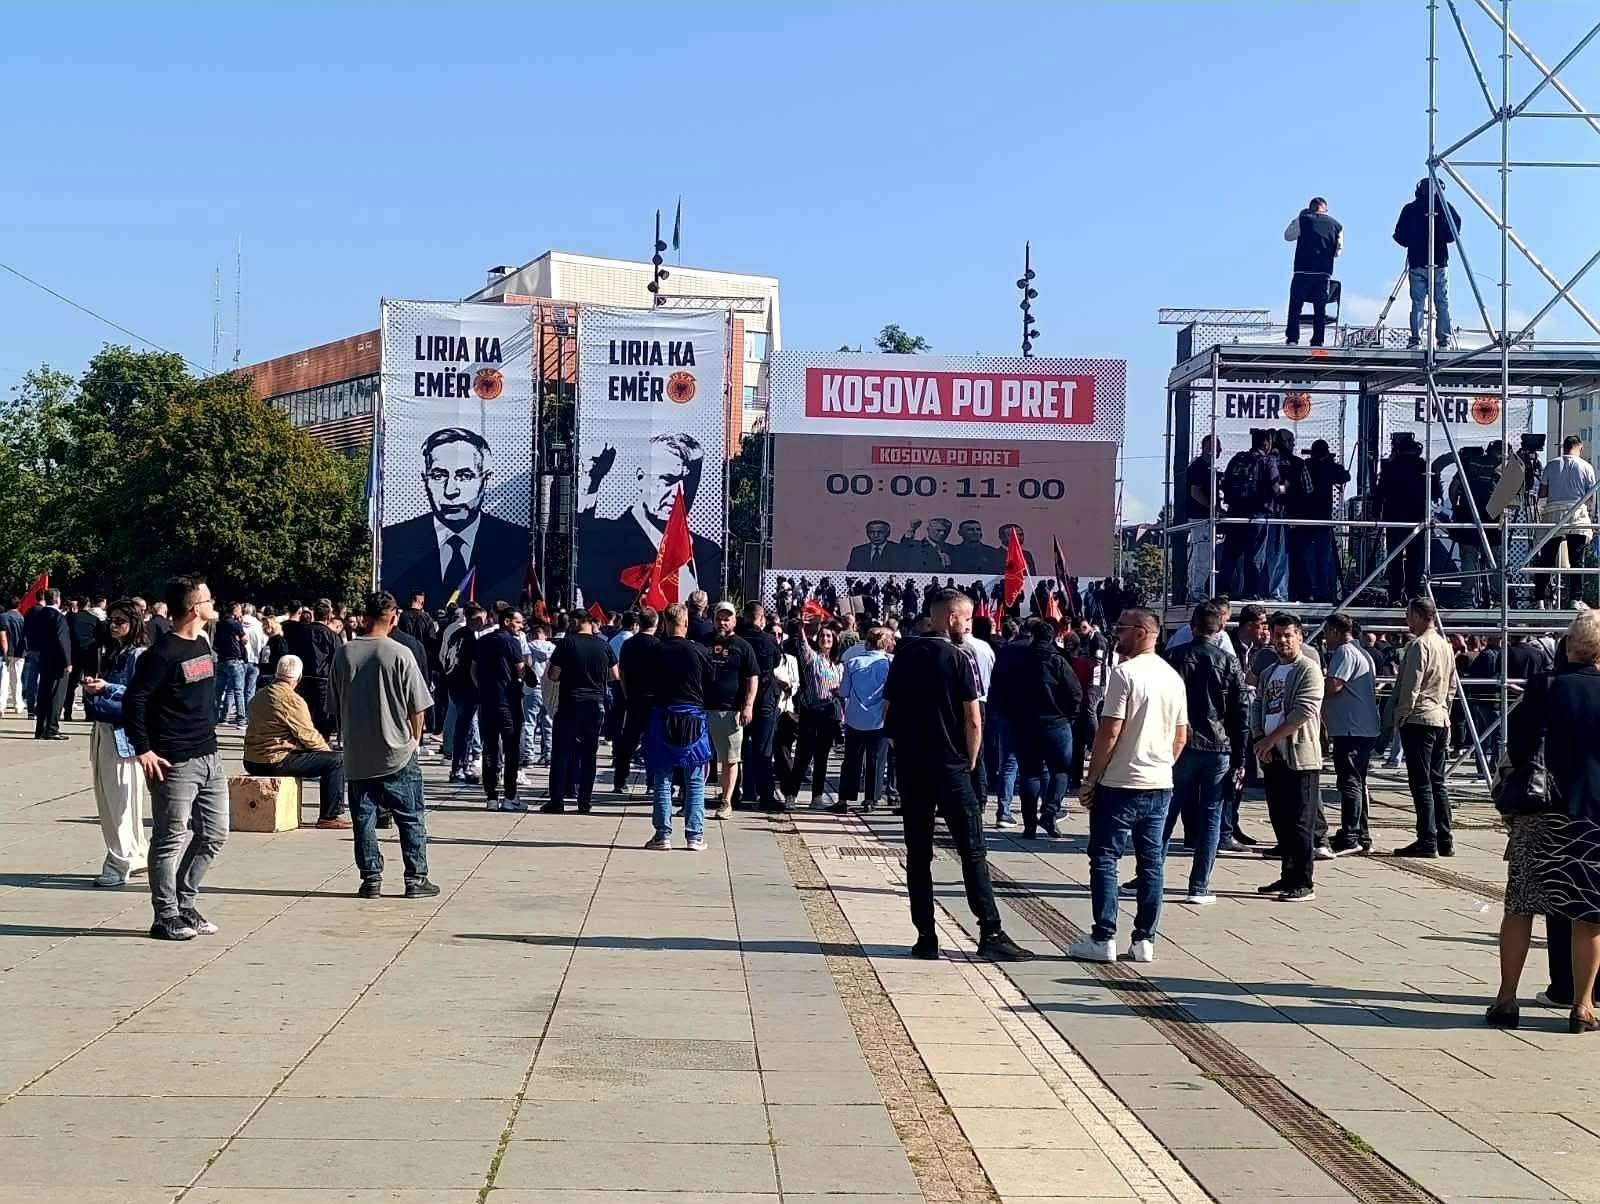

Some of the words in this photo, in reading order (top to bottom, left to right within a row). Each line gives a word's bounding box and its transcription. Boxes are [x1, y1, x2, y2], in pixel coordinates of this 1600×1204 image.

[415, 335, 470, 362] LIRIA
[475, 337, 503, 363] KA
[609, 340, 664, 366] LIRIA
[668, 341, 696, 367] KA
[414, 366, 471, 398] EMËR
[608, 371, 664, 402] EMËR
[822, 374, 942, 415] KOSOVA
[951, 378, 993, 416] PO
[1001, 380, 1078, 419] PRET
[879, 447, 942, 464] KOSOVA
[946, 449, 968, 465] PO
[972, 450, 1012, 466] PRET
